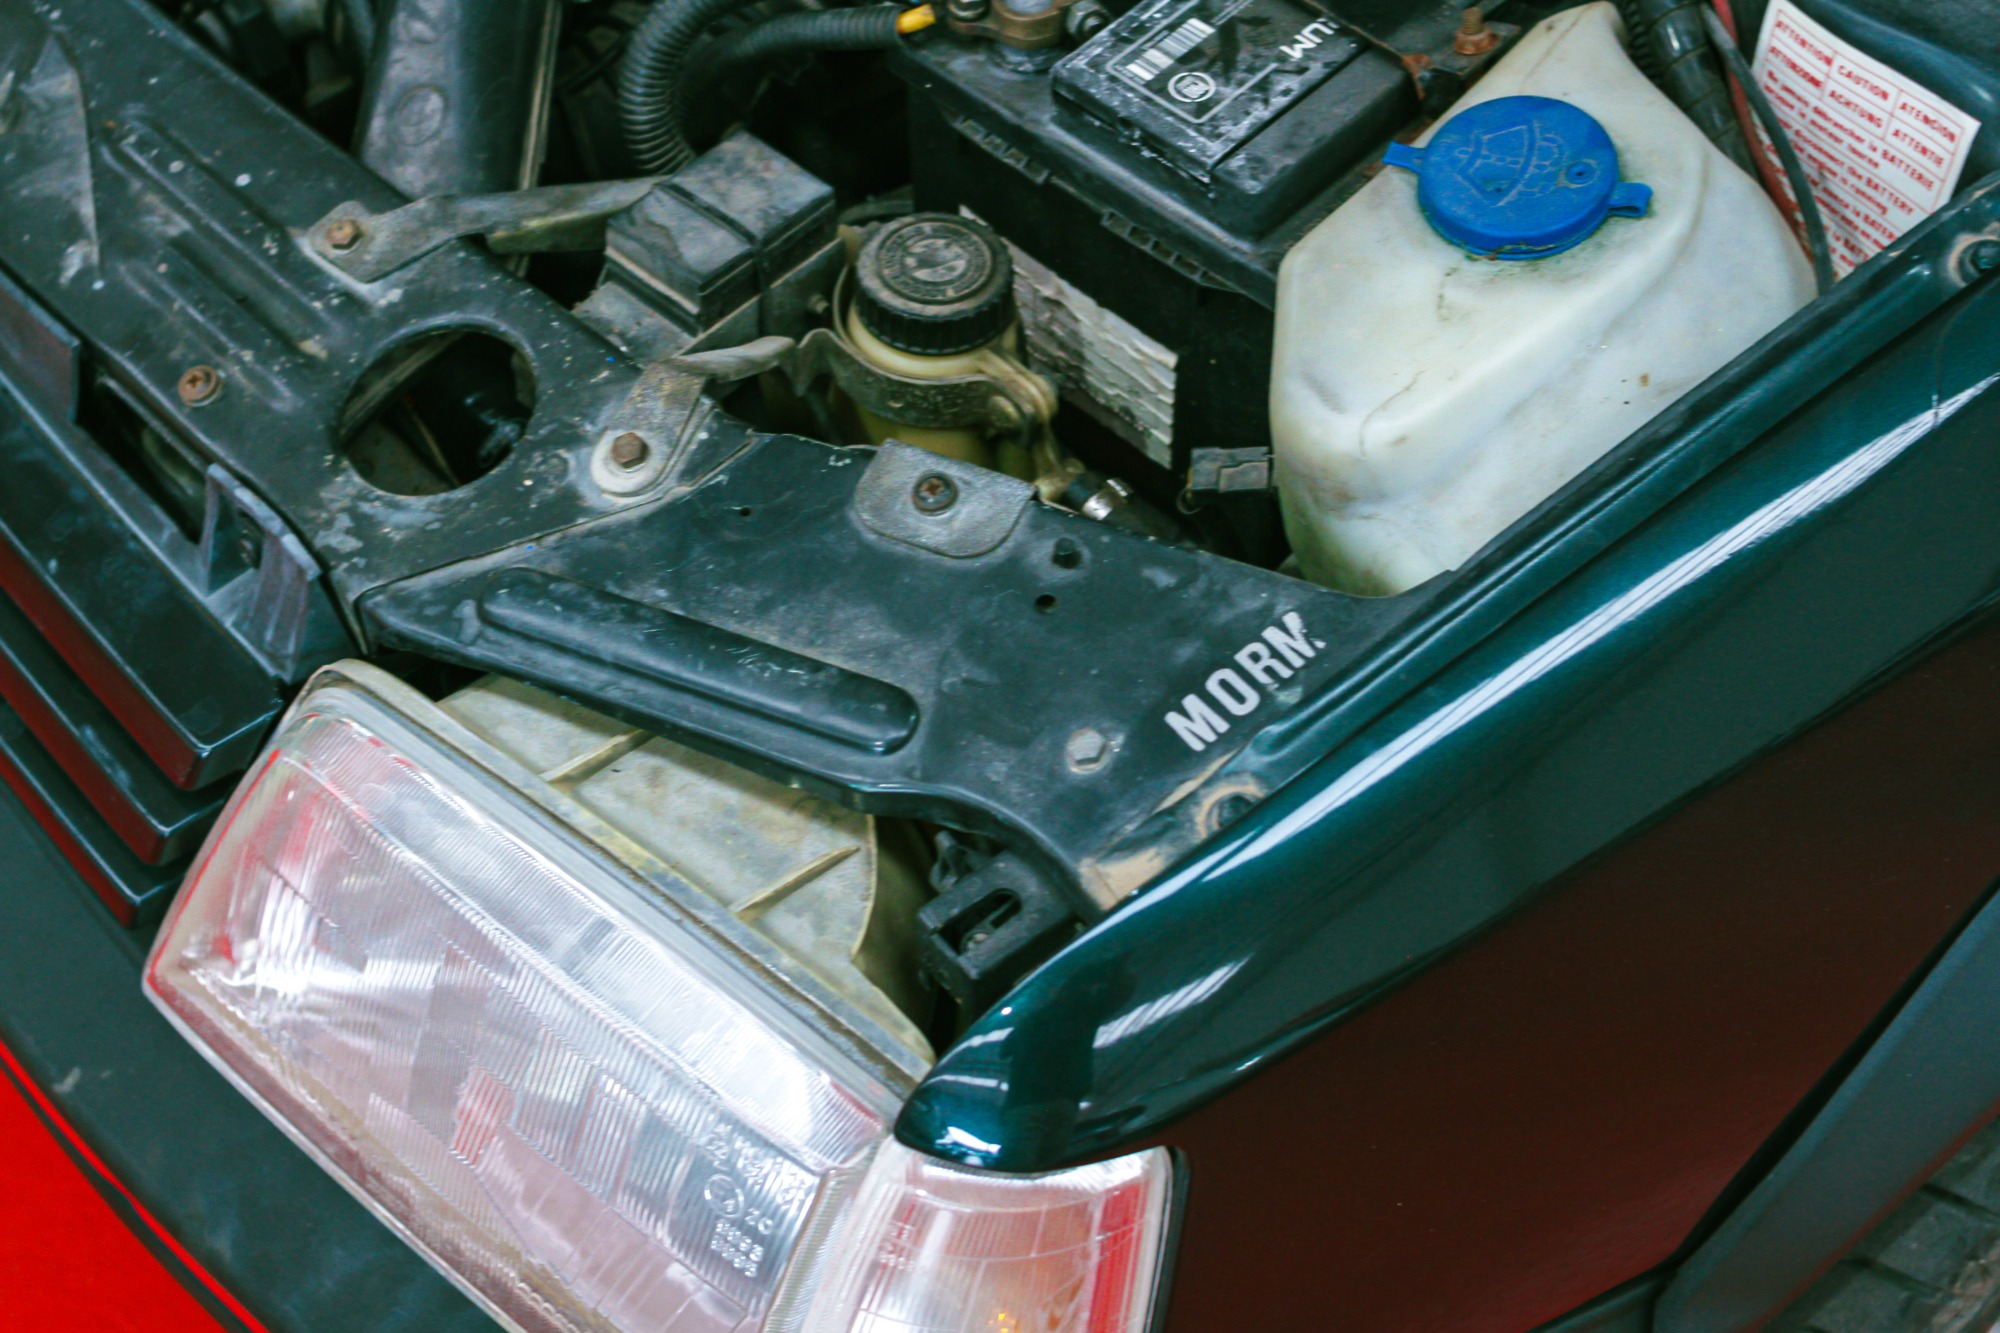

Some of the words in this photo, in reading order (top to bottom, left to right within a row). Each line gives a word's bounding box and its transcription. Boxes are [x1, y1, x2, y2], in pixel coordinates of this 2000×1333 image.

[1776, 20, 1833, 67] ATTENTION
[1839, 65, 1889, 101] CAUTION
[1829, 90, 1882, 128] ACHTUNG
[1892, 129, 1943, 166] ATTENTIE
[1882, 149, 1933, 189] BATTERIE
[1847, 166, 1864, 181] the
[1865, 177, 1913, 213] BATTERY
[1851, 184, 1888, 216] running
